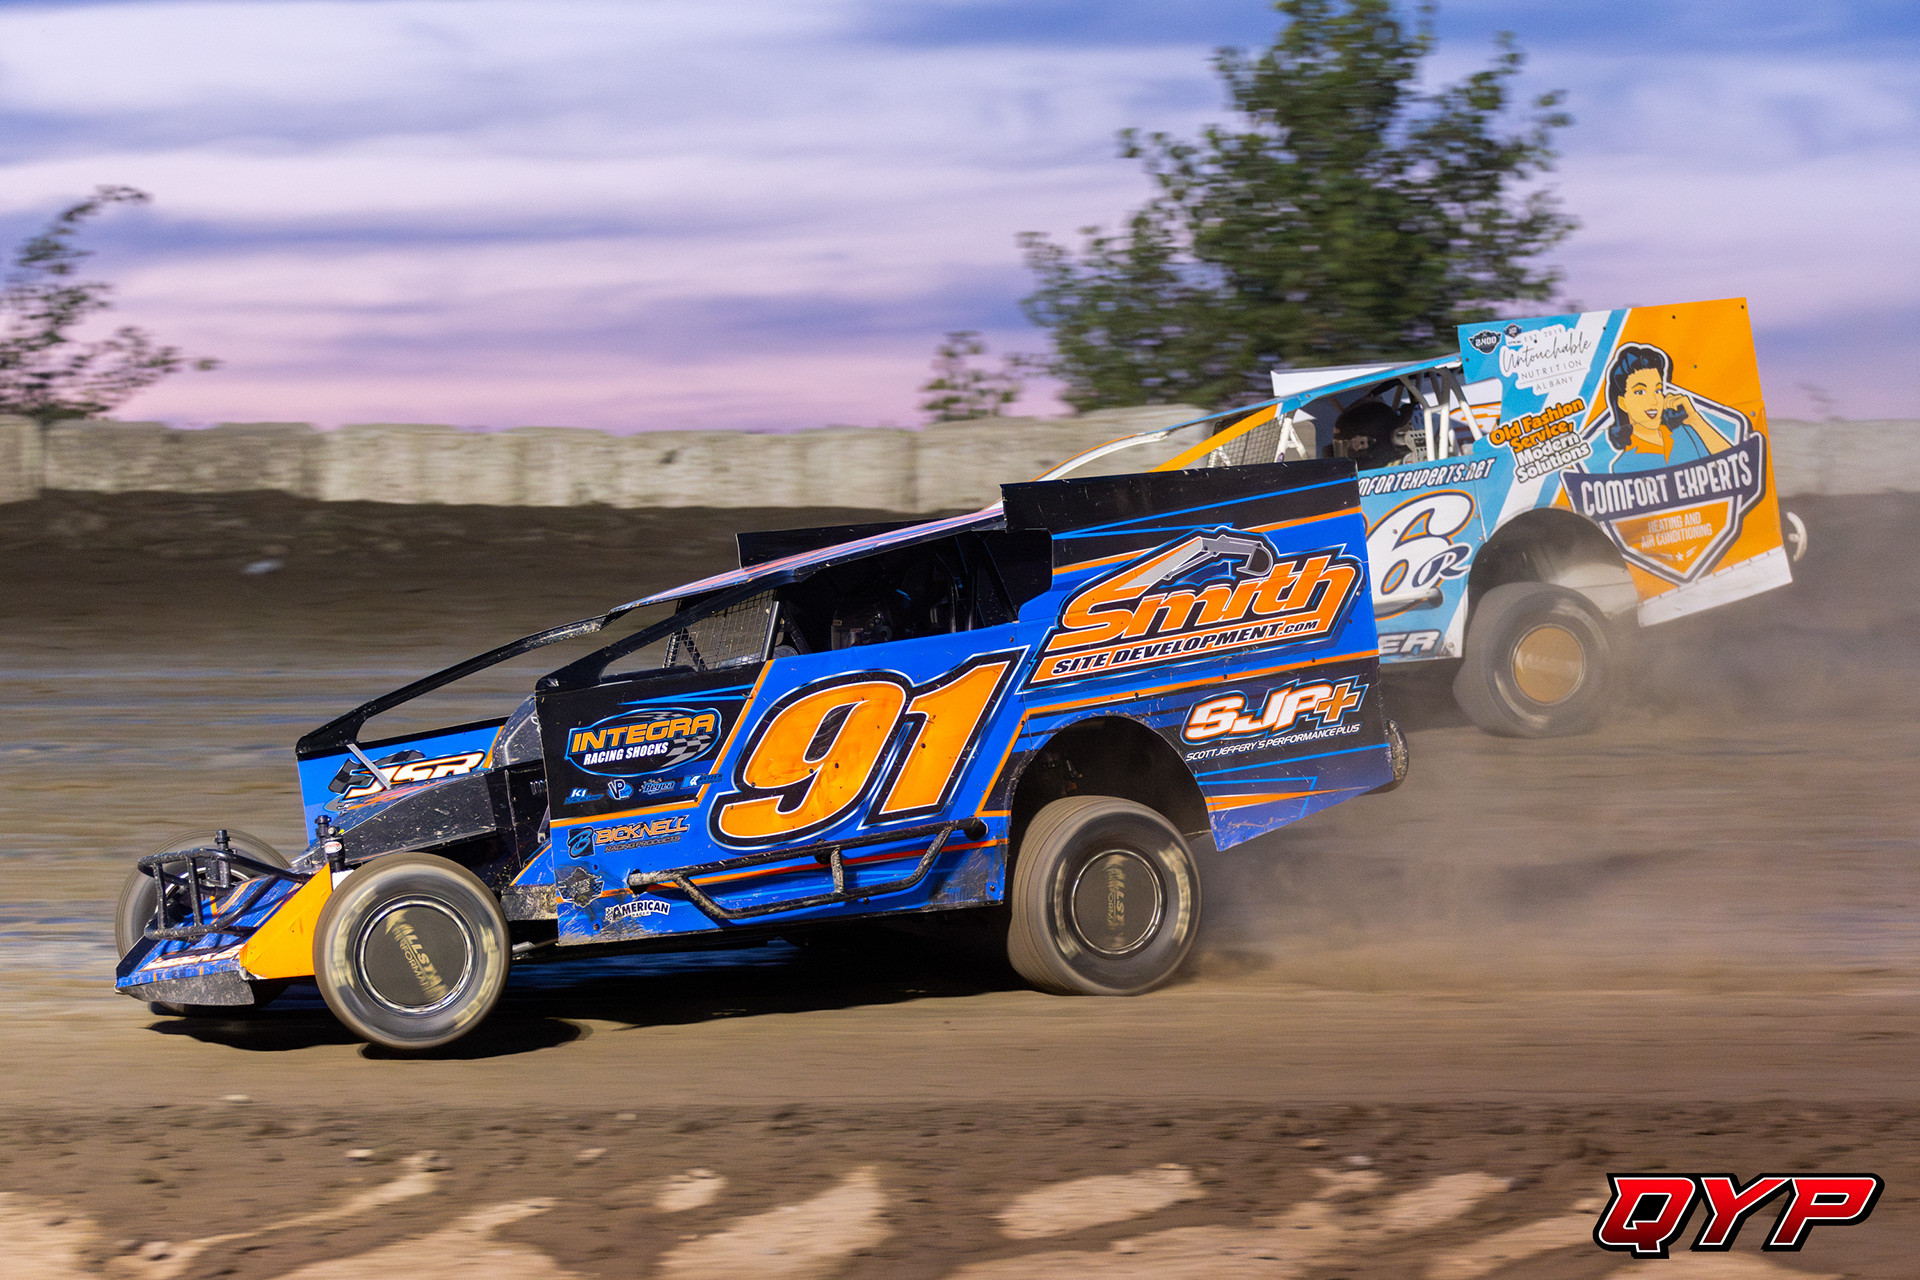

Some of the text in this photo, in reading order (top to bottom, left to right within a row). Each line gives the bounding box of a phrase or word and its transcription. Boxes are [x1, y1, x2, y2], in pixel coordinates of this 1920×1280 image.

[1503, 331, 1592, 373] Untouchable
[1521, 360, 1582, 380] NUTRITION
[1536, 376, 1574, 391] ALBANY
[1490, 398, 1585, 445] Old Fashion
[1516, 432, 1581, 466] Modern
[1516, 442, 1591, 483] Solutions
[1581, 450, 1752, 517] COMFORT EXPERTS
[1641, 522, 1713, 549] AIR CONDITIONING
[1647, 511, 1702, 534] HEATING AND
[1046, 540, 1356, 652] Smith
[1051, 619, 1319, 676] SITE DEVELOPMENT.COM
[571, 713, 716, 753] INTEGRA
[711, 651, 1020, 846] 91
[1185, 723, 1361, 762] SCOTT JEFFERY'S PERFORMANCE PLUS
[583, 741, 669, 766] RACING SHOCKS
[608, 779, 626, 800] VP
[594, 817, 689, 845] BICKNELL
[604, 835, 681, 853] RACING PRODUCTS
[612, 901, 670, 919] AMERICAN
